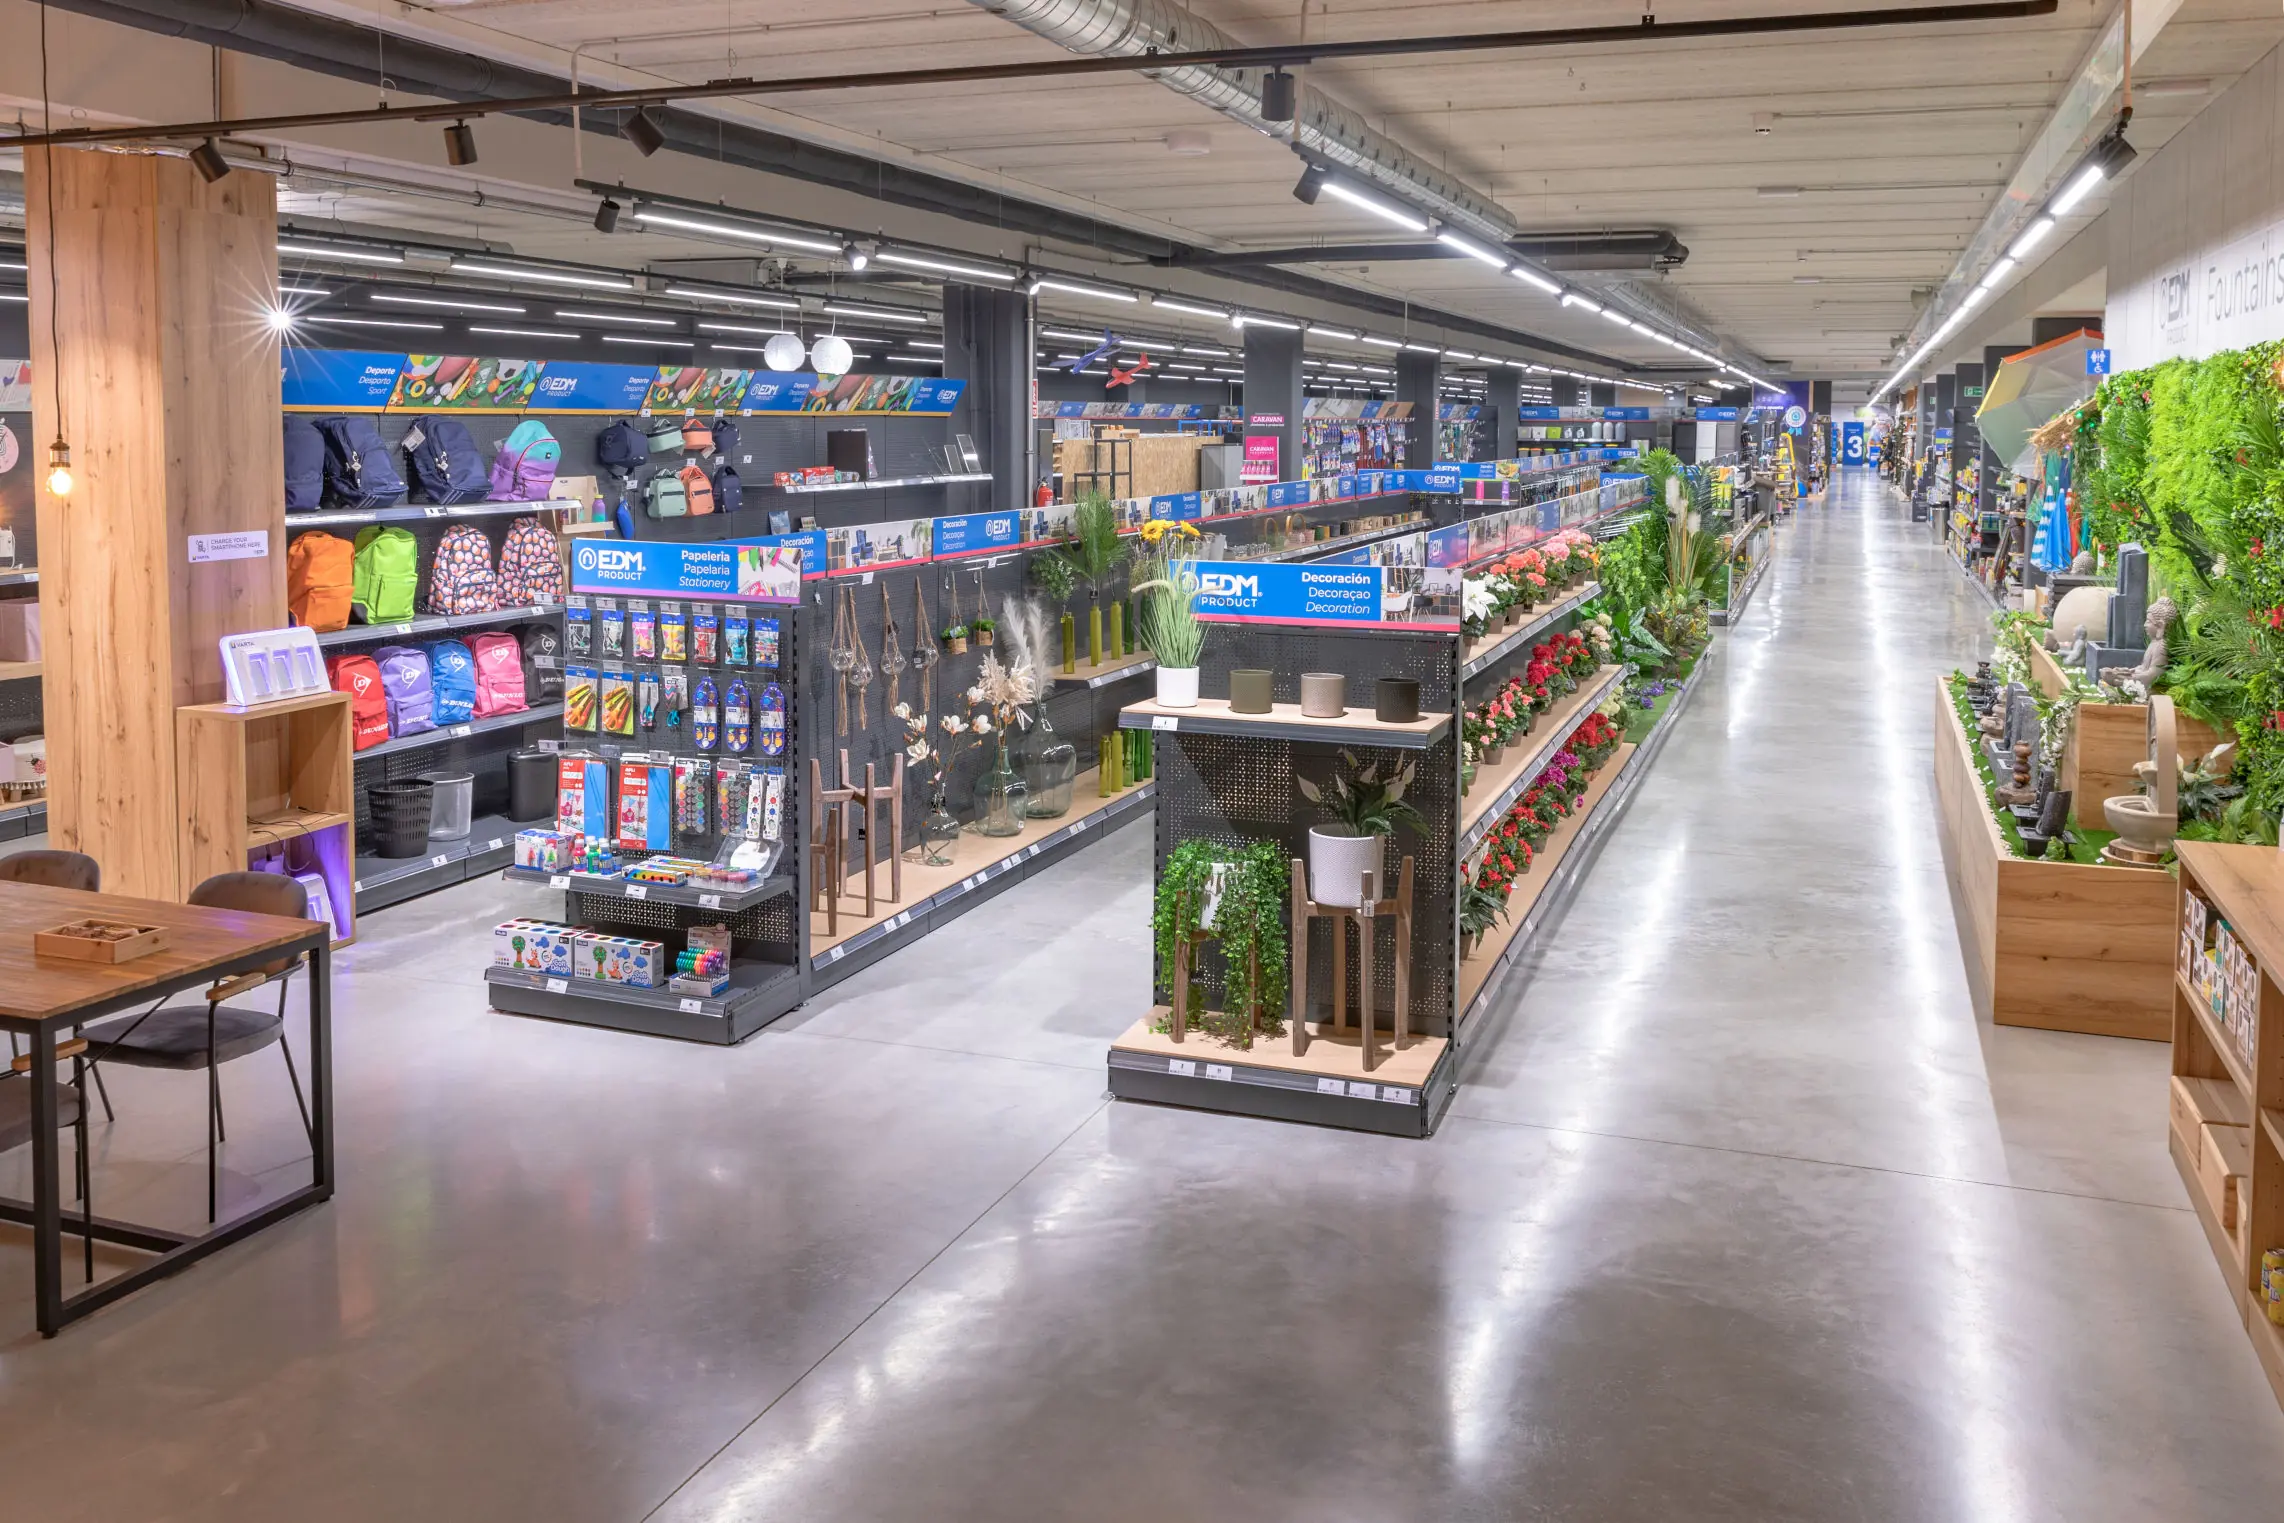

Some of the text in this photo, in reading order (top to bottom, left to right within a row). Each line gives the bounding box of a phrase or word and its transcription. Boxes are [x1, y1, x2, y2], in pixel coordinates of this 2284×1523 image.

[2206, 240, 2284, 325] Fountains
[365, 366, 396, 376] Deporte
[358, 376, 392, 386] Desporto
[549, 377, 578, 391] EDM
[367, 386, 388, 396] Sport
[758, 384, 779, 396] EDM
[1847, 435, 1863, 459] 3
[1434, 475, 1455, 484] EDM
[993, 518, 1011, 535] EDM
[210, 542, 247, 551] SMARTPHONE
[780, 535, 814, 548] Decoración
[598, 547, 643, 572] EDM
[597, 563, 730, 581] PRODUCT Papelaria
[679, 576, 731, 591] Stationery
[1201, 571, 1371, 597] EDM Decoración
[1201, 587, 1371, 608] PRODUCT Decoraçao
[1305, 601, 1371, 615] Decoration
[449, 699, 474, 709] DUNLO
[550, 964, 571, 973] Dough
